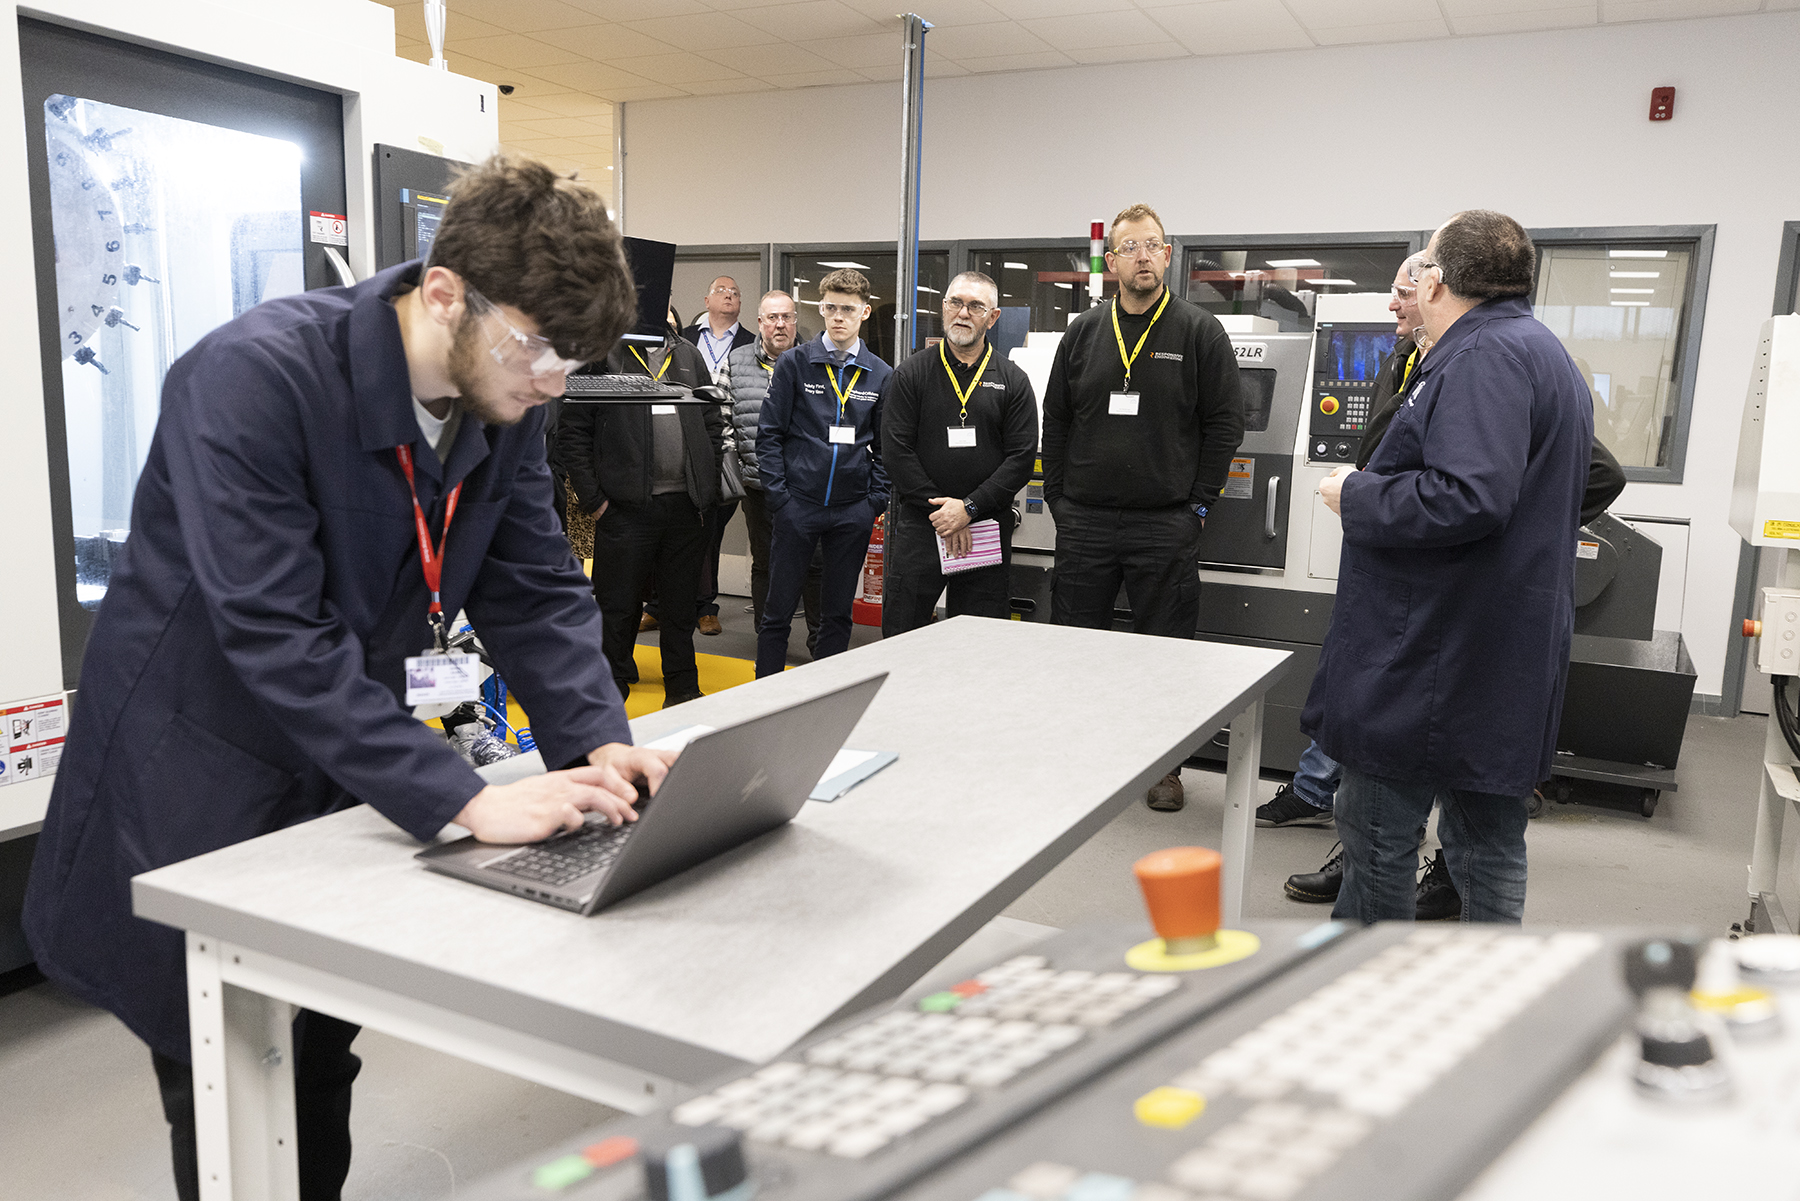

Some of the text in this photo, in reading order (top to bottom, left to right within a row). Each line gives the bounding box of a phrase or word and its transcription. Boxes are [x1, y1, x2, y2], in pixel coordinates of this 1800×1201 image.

[105, 240, 120, 252] 6
[102, 274, 117, 286] 5
[91, 304, 105, 317] 4
[68, 331, 83, 345] 3
